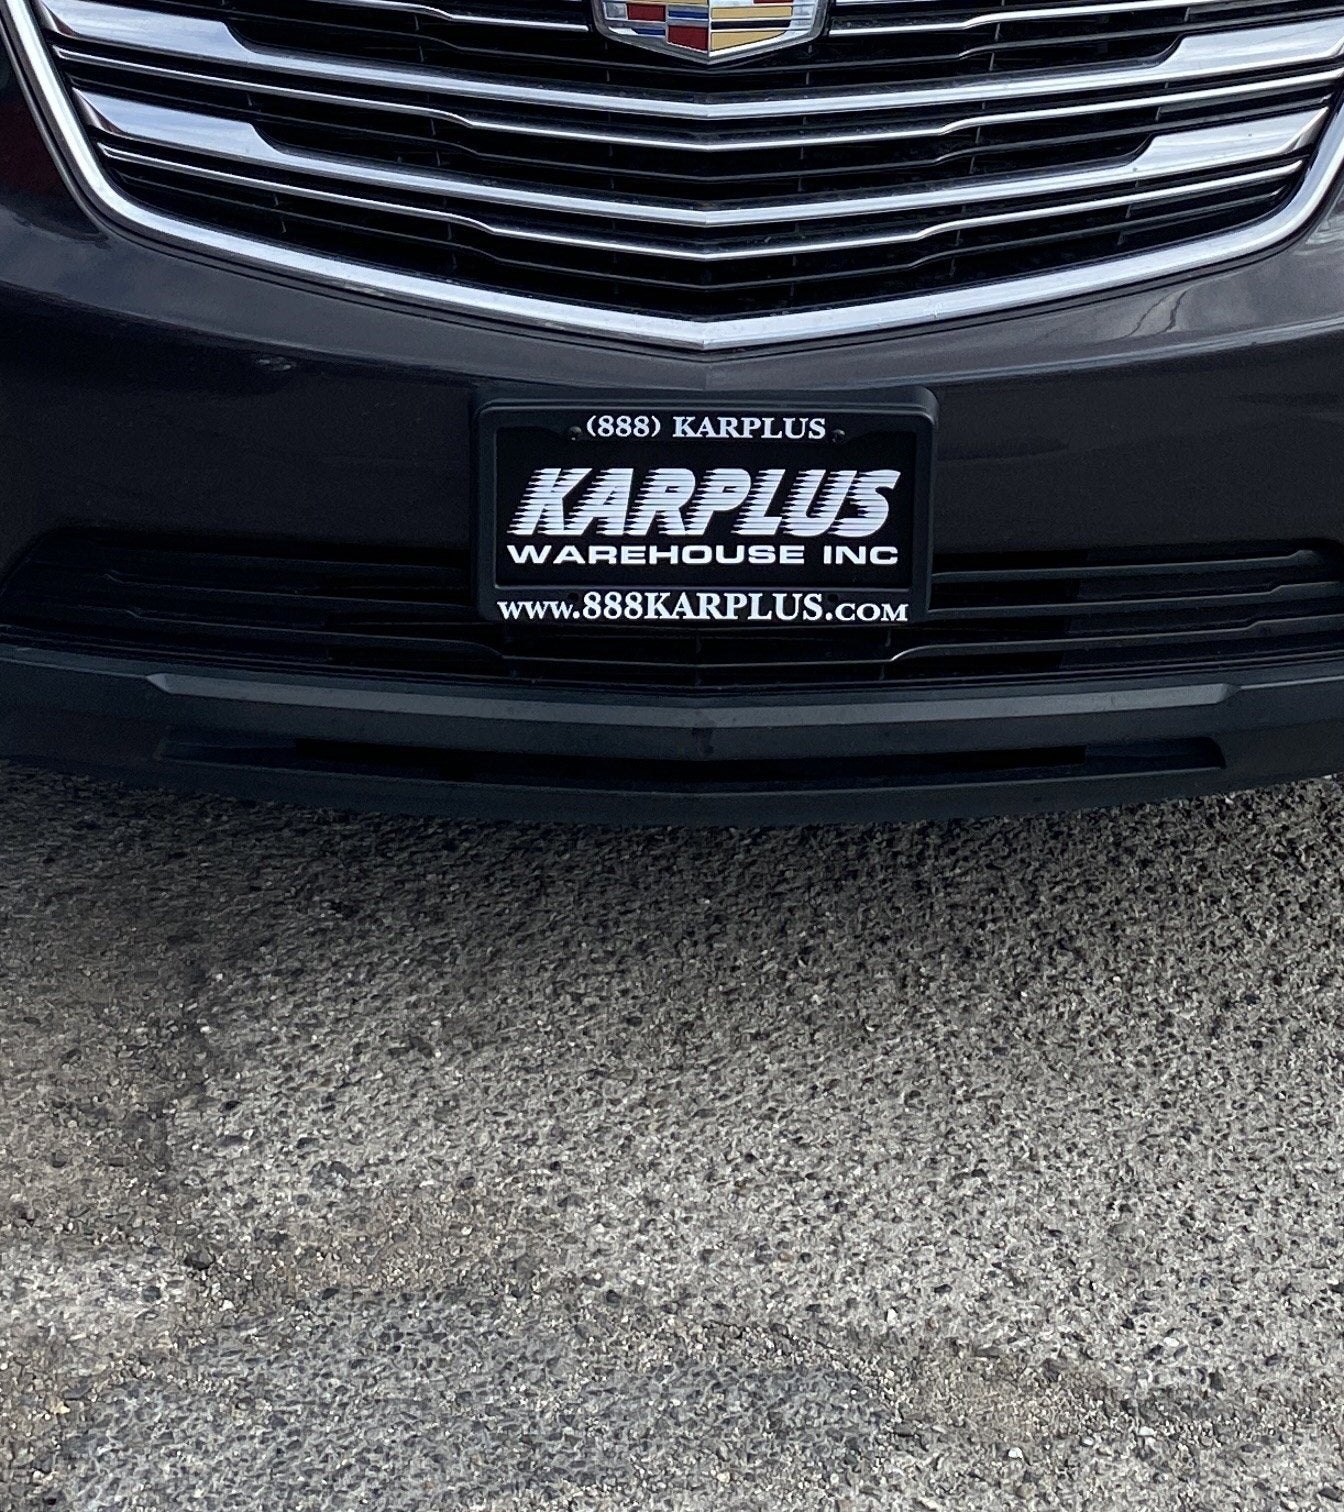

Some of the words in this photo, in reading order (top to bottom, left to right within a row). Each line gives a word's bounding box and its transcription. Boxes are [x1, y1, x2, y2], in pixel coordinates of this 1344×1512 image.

[586, 415, 661, 439] (888)
[672, 417, 826, 440] KARPLUS
[507, 467, 902, 538] KARPLUS
[507, 545, 805, 564] WAREHOUSE
[823, 545, 899, 565] INC
